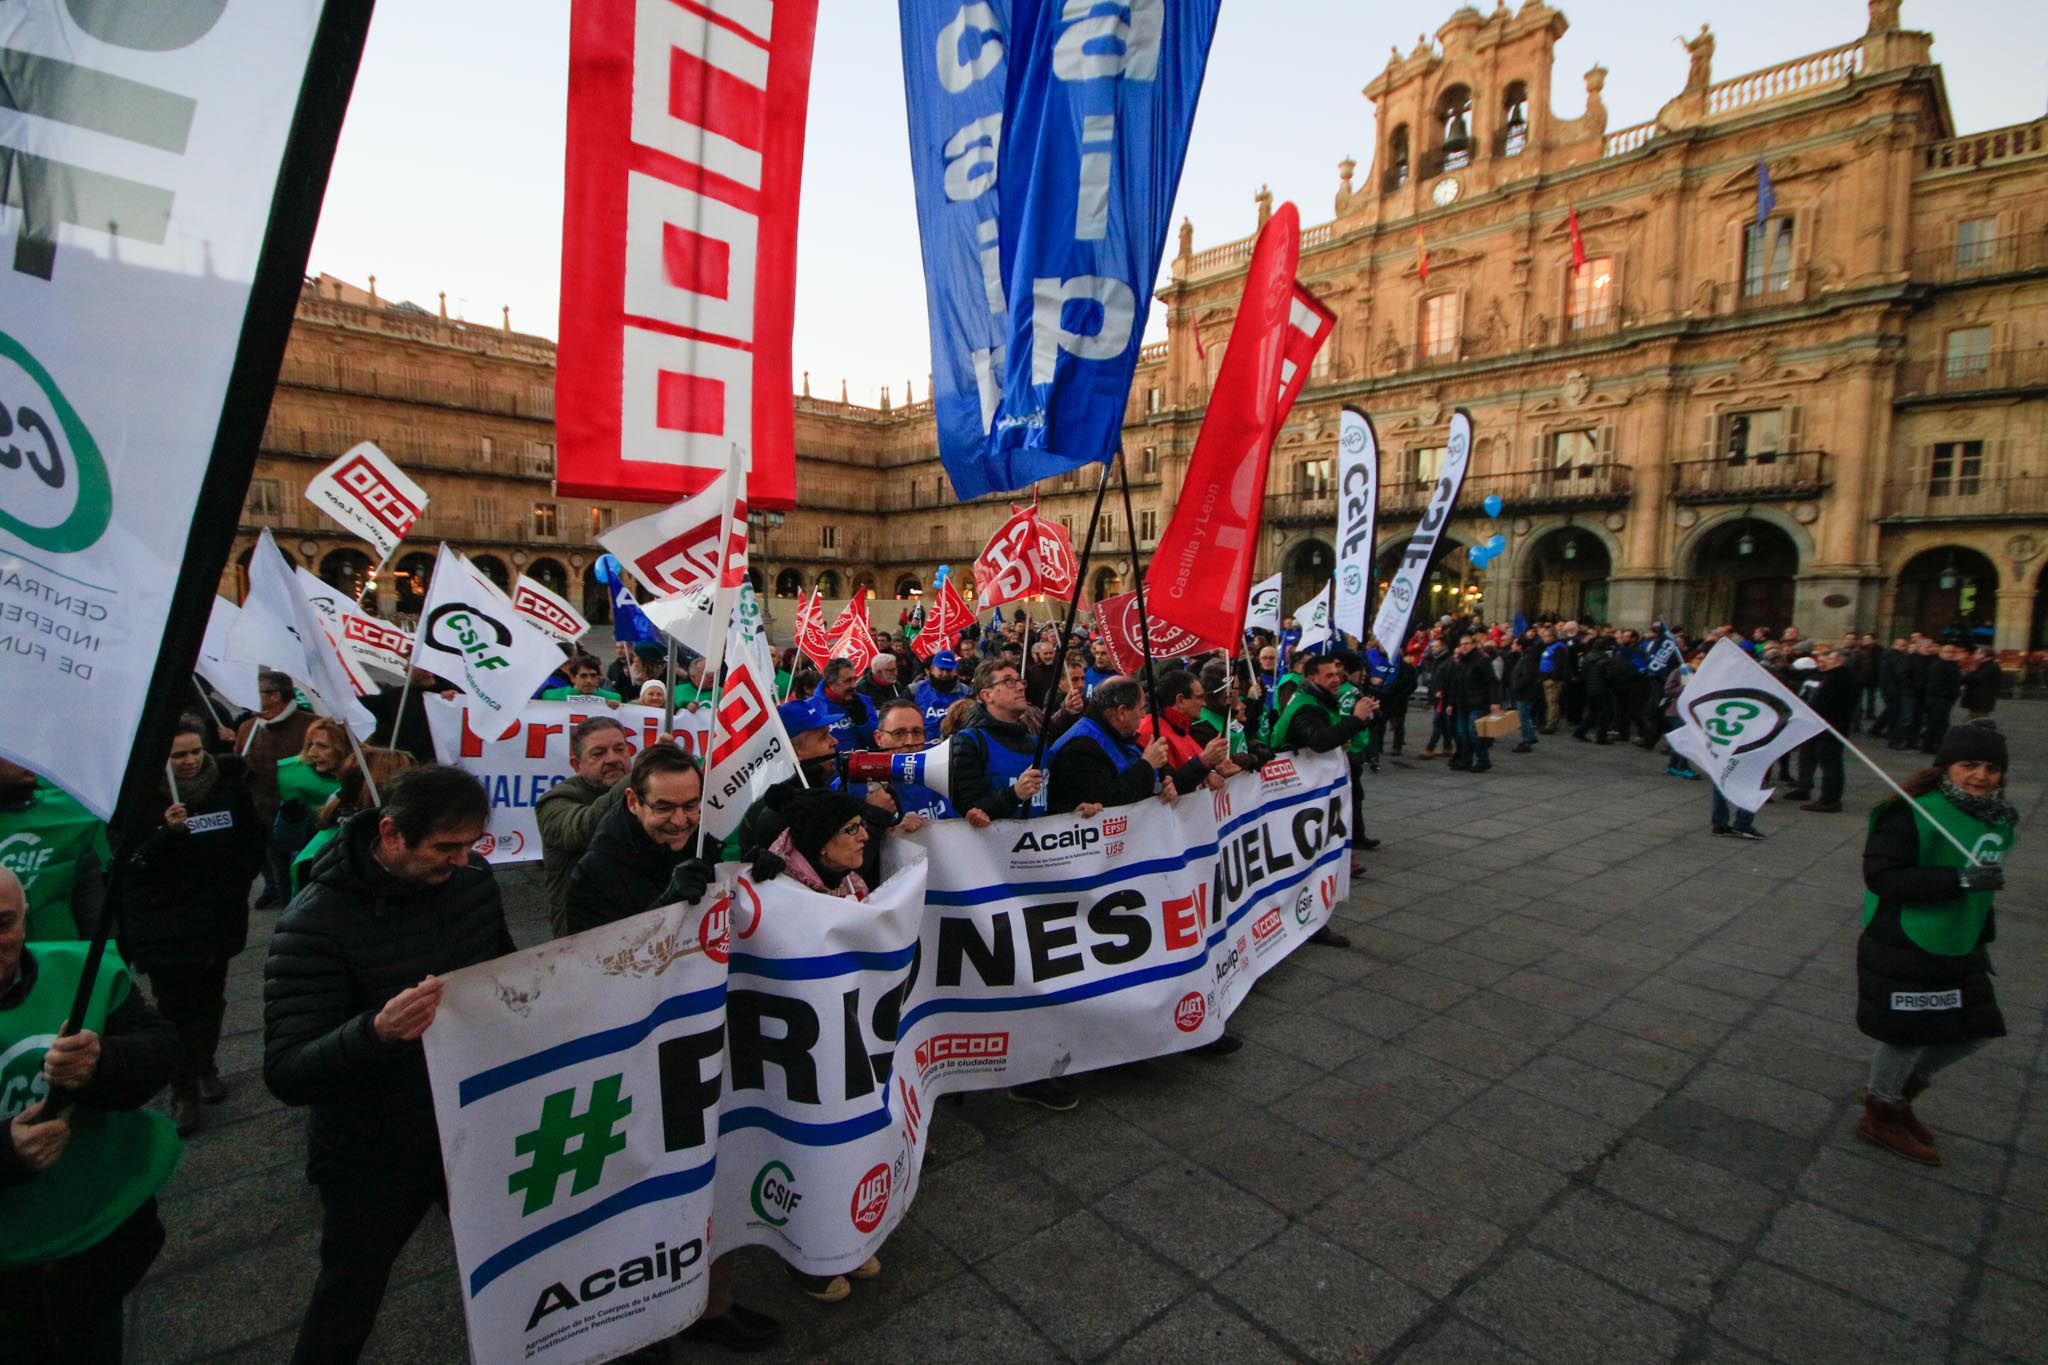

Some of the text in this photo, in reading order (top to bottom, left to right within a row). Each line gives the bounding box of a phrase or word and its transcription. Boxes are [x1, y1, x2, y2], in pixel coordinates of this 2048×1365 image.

[620, 0, 774, 473] COO
[1169, 540, 1202, 600] Castilla
[1193, 528, 1207, 537] y
[1264, 762, 1295, 778] CCOO
[1011, 823, 1100, 853] Acaip
[1895, 993, 1958, 1008] PRISIONES
[934, 1036, 1004, 1058] CCOO
[947, 1059, 956, 1068] la
[763, 1178, 803, 1213] CSIF
[524, 1238, 703, 1333] Acaip
[525, 1324, 571, 1351] Agrupación
[572, 1318, 583, 1328] de
[584, 1313, 596, 1323] los
[597, 1302, 630, 1319] Cuerpos
[631, 1297, 642, 1306] de
[643, 1295, 651, 1303] la
[525, 1306, 646, 1359] de Instituciones Penitenciarias
